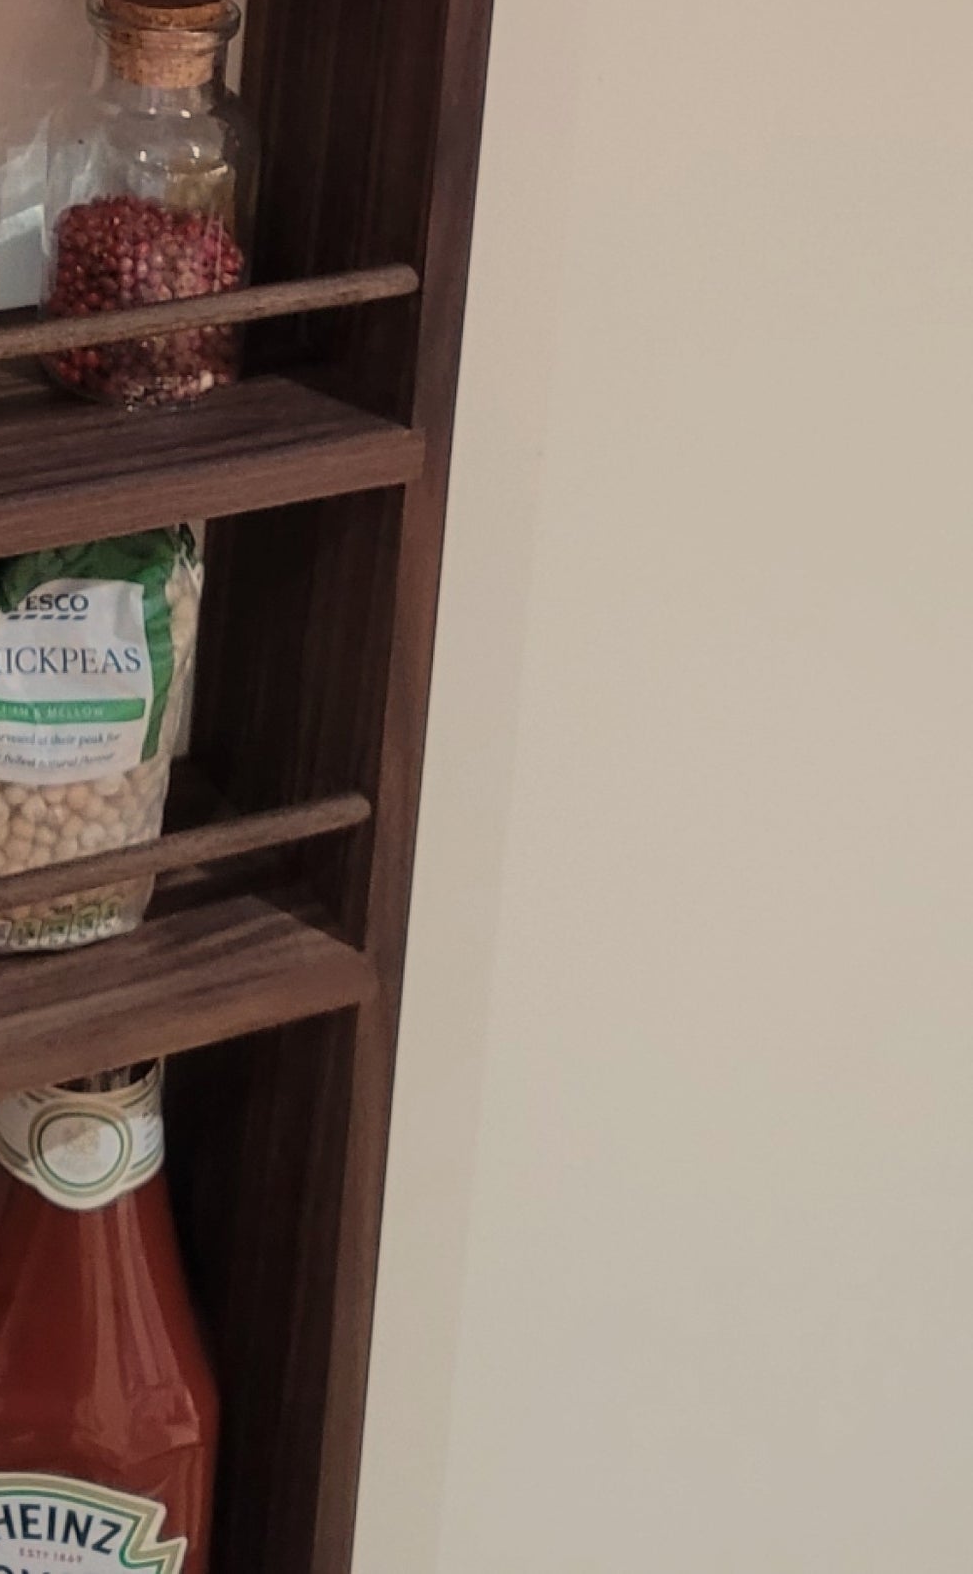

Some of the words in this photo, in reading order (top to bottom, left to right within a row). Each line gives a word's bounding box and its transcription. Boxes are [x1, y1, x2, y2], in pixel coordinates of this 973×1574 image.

[24, 593, 90, 613] ESCO
[50, 729, 77, 746] their
[78, 730, 104, 748] peak
[106, 729, 121, 746] for
